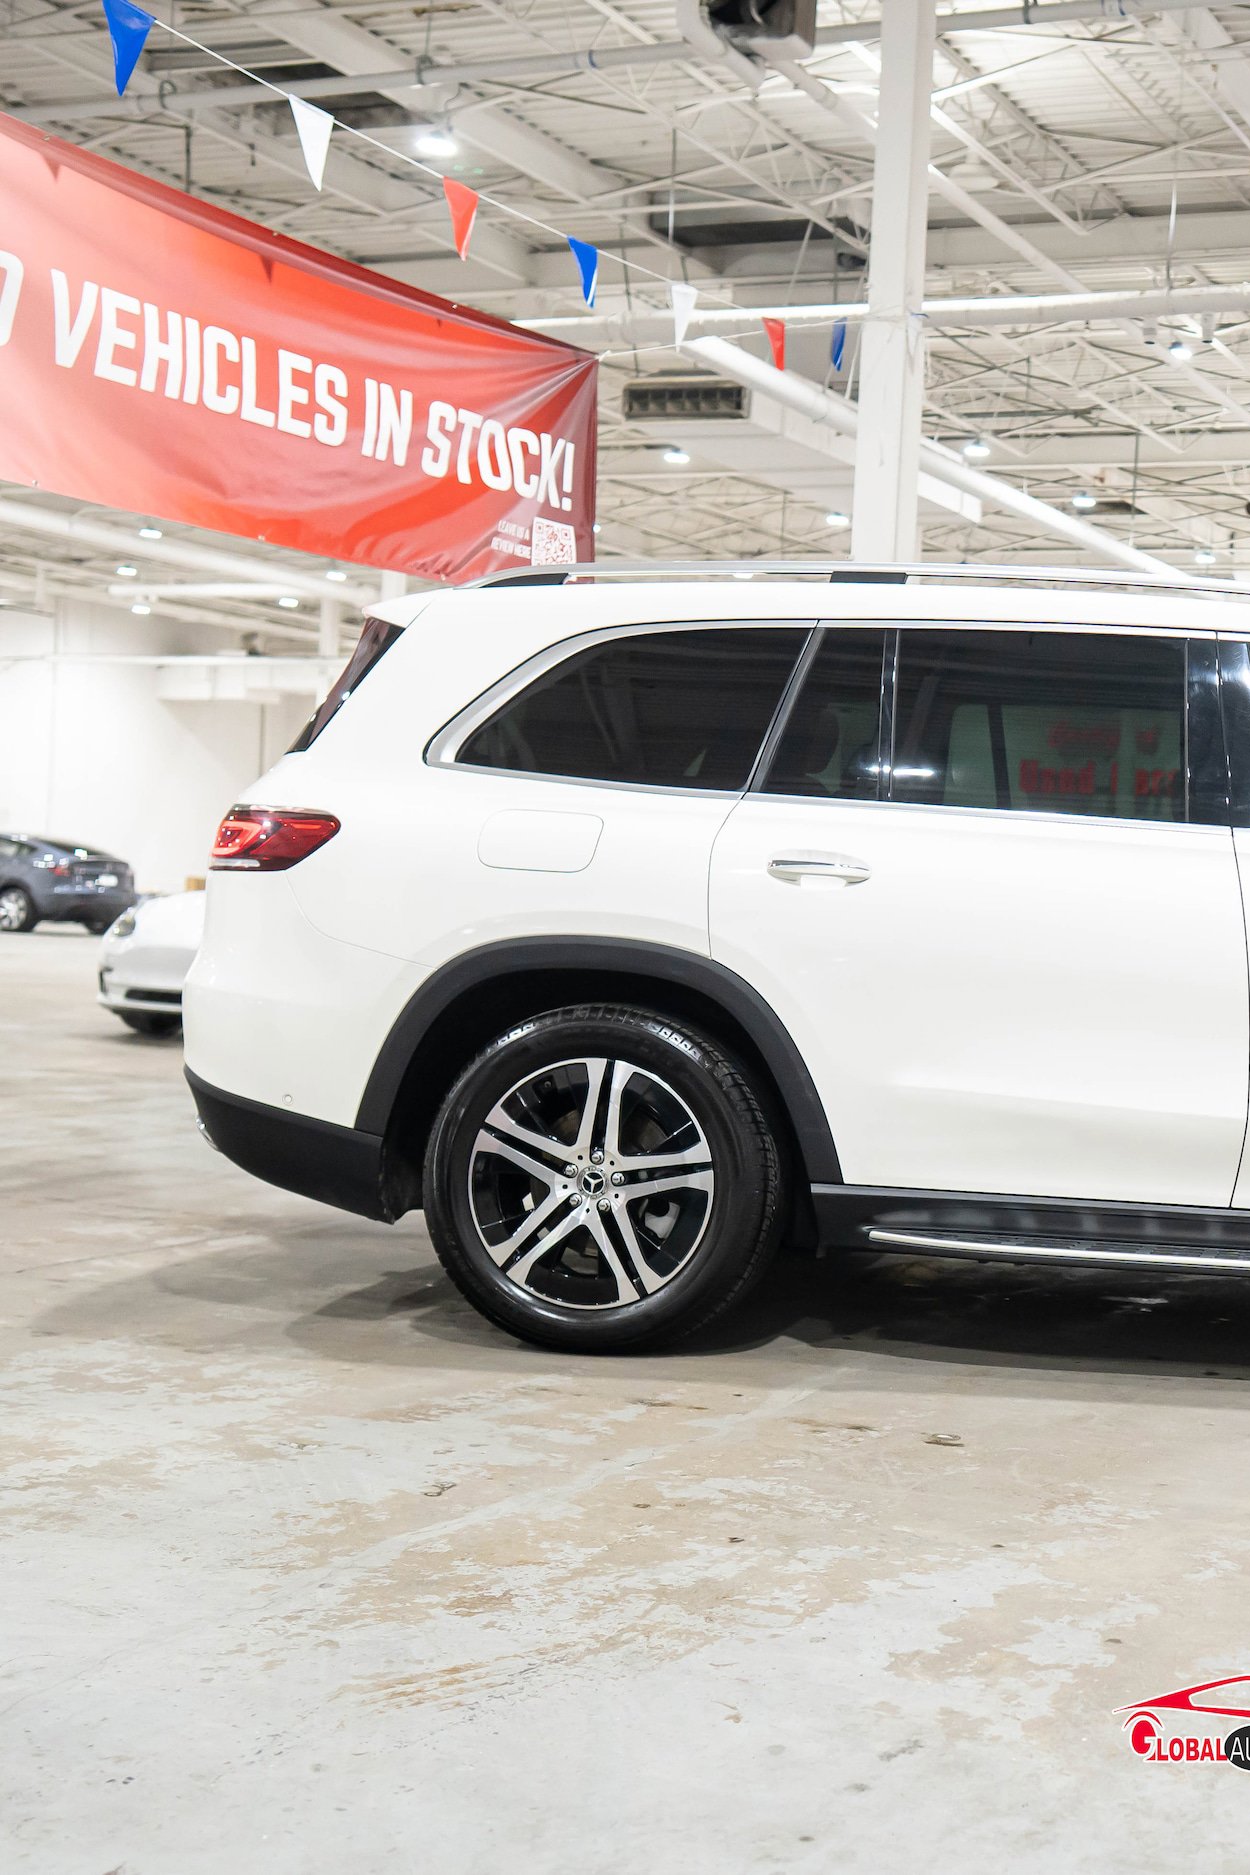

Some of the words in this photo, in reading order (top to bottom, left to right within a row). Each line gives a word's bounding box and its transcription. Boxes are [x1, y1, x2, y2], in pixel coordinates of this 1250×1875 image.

[50, 268, 349, 448] VEHICLES
[361, 377, 413, 467] IN
[420, 400, 576, 512] STOCK!
